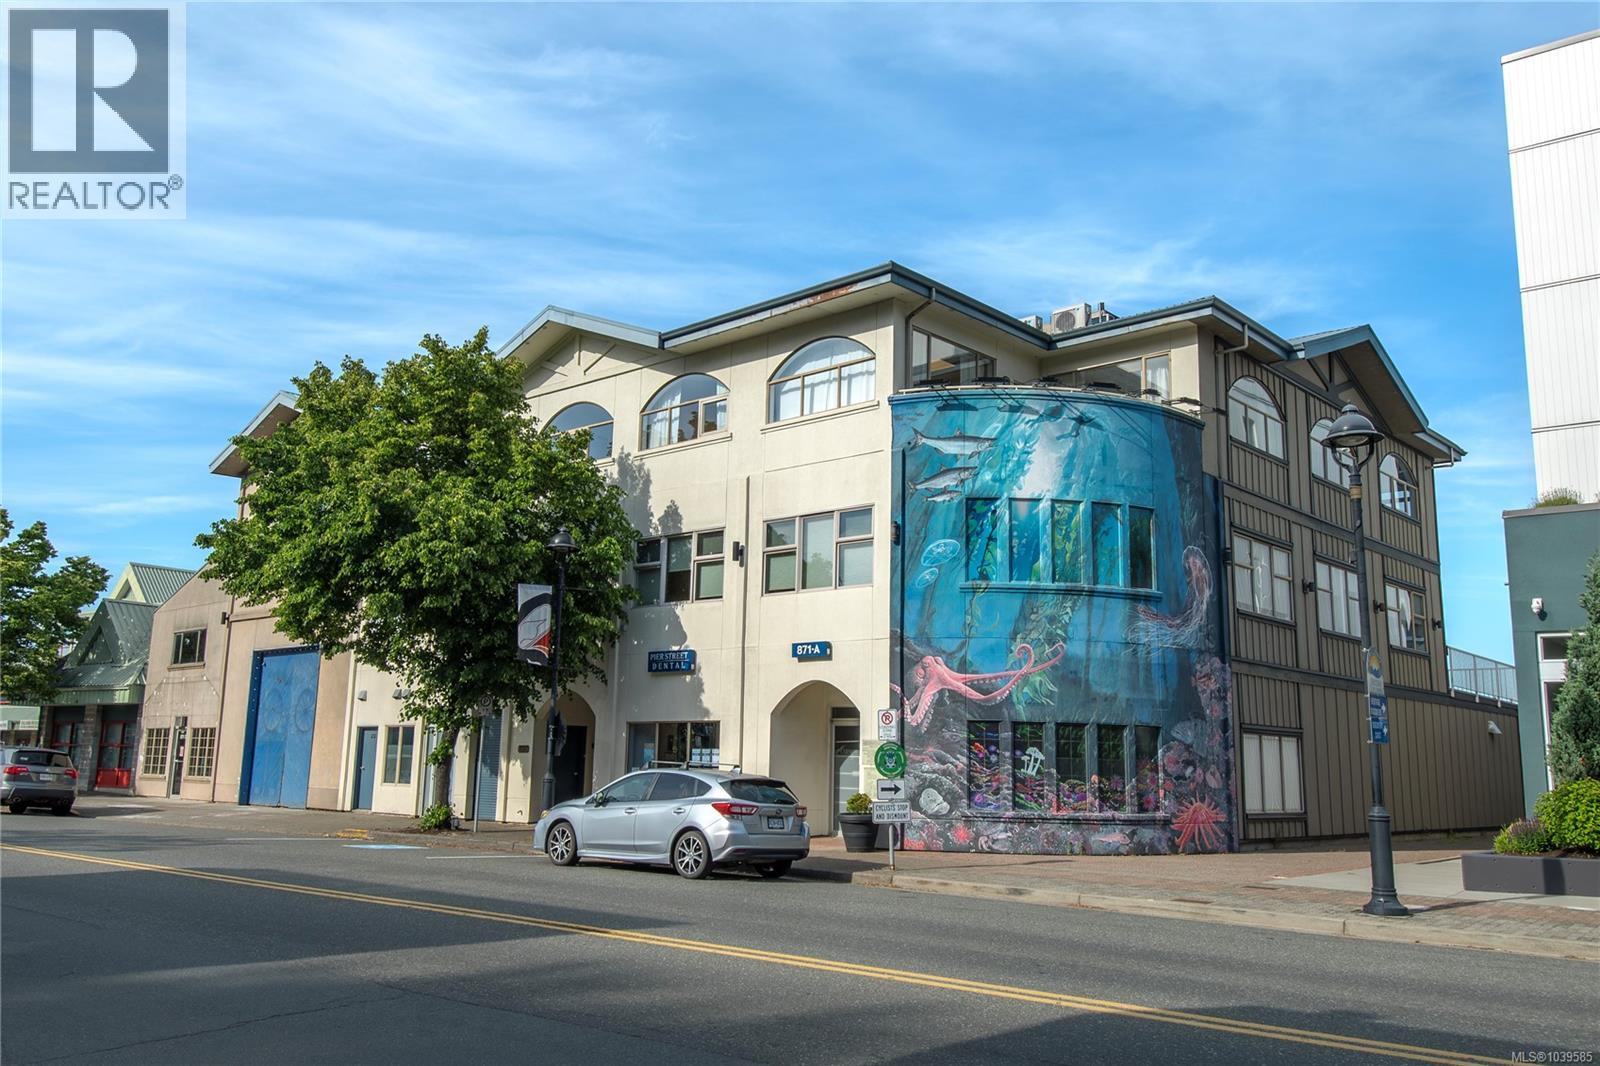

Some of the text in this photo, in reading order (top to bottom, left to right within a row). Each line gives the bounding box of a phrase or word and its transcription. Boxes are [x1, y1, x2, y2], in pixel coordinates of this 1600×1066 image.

[664, 651, 688, 660] STREET
[652, 661, 686, 670] DENTAL
[875, 812, 885, 820] AND
